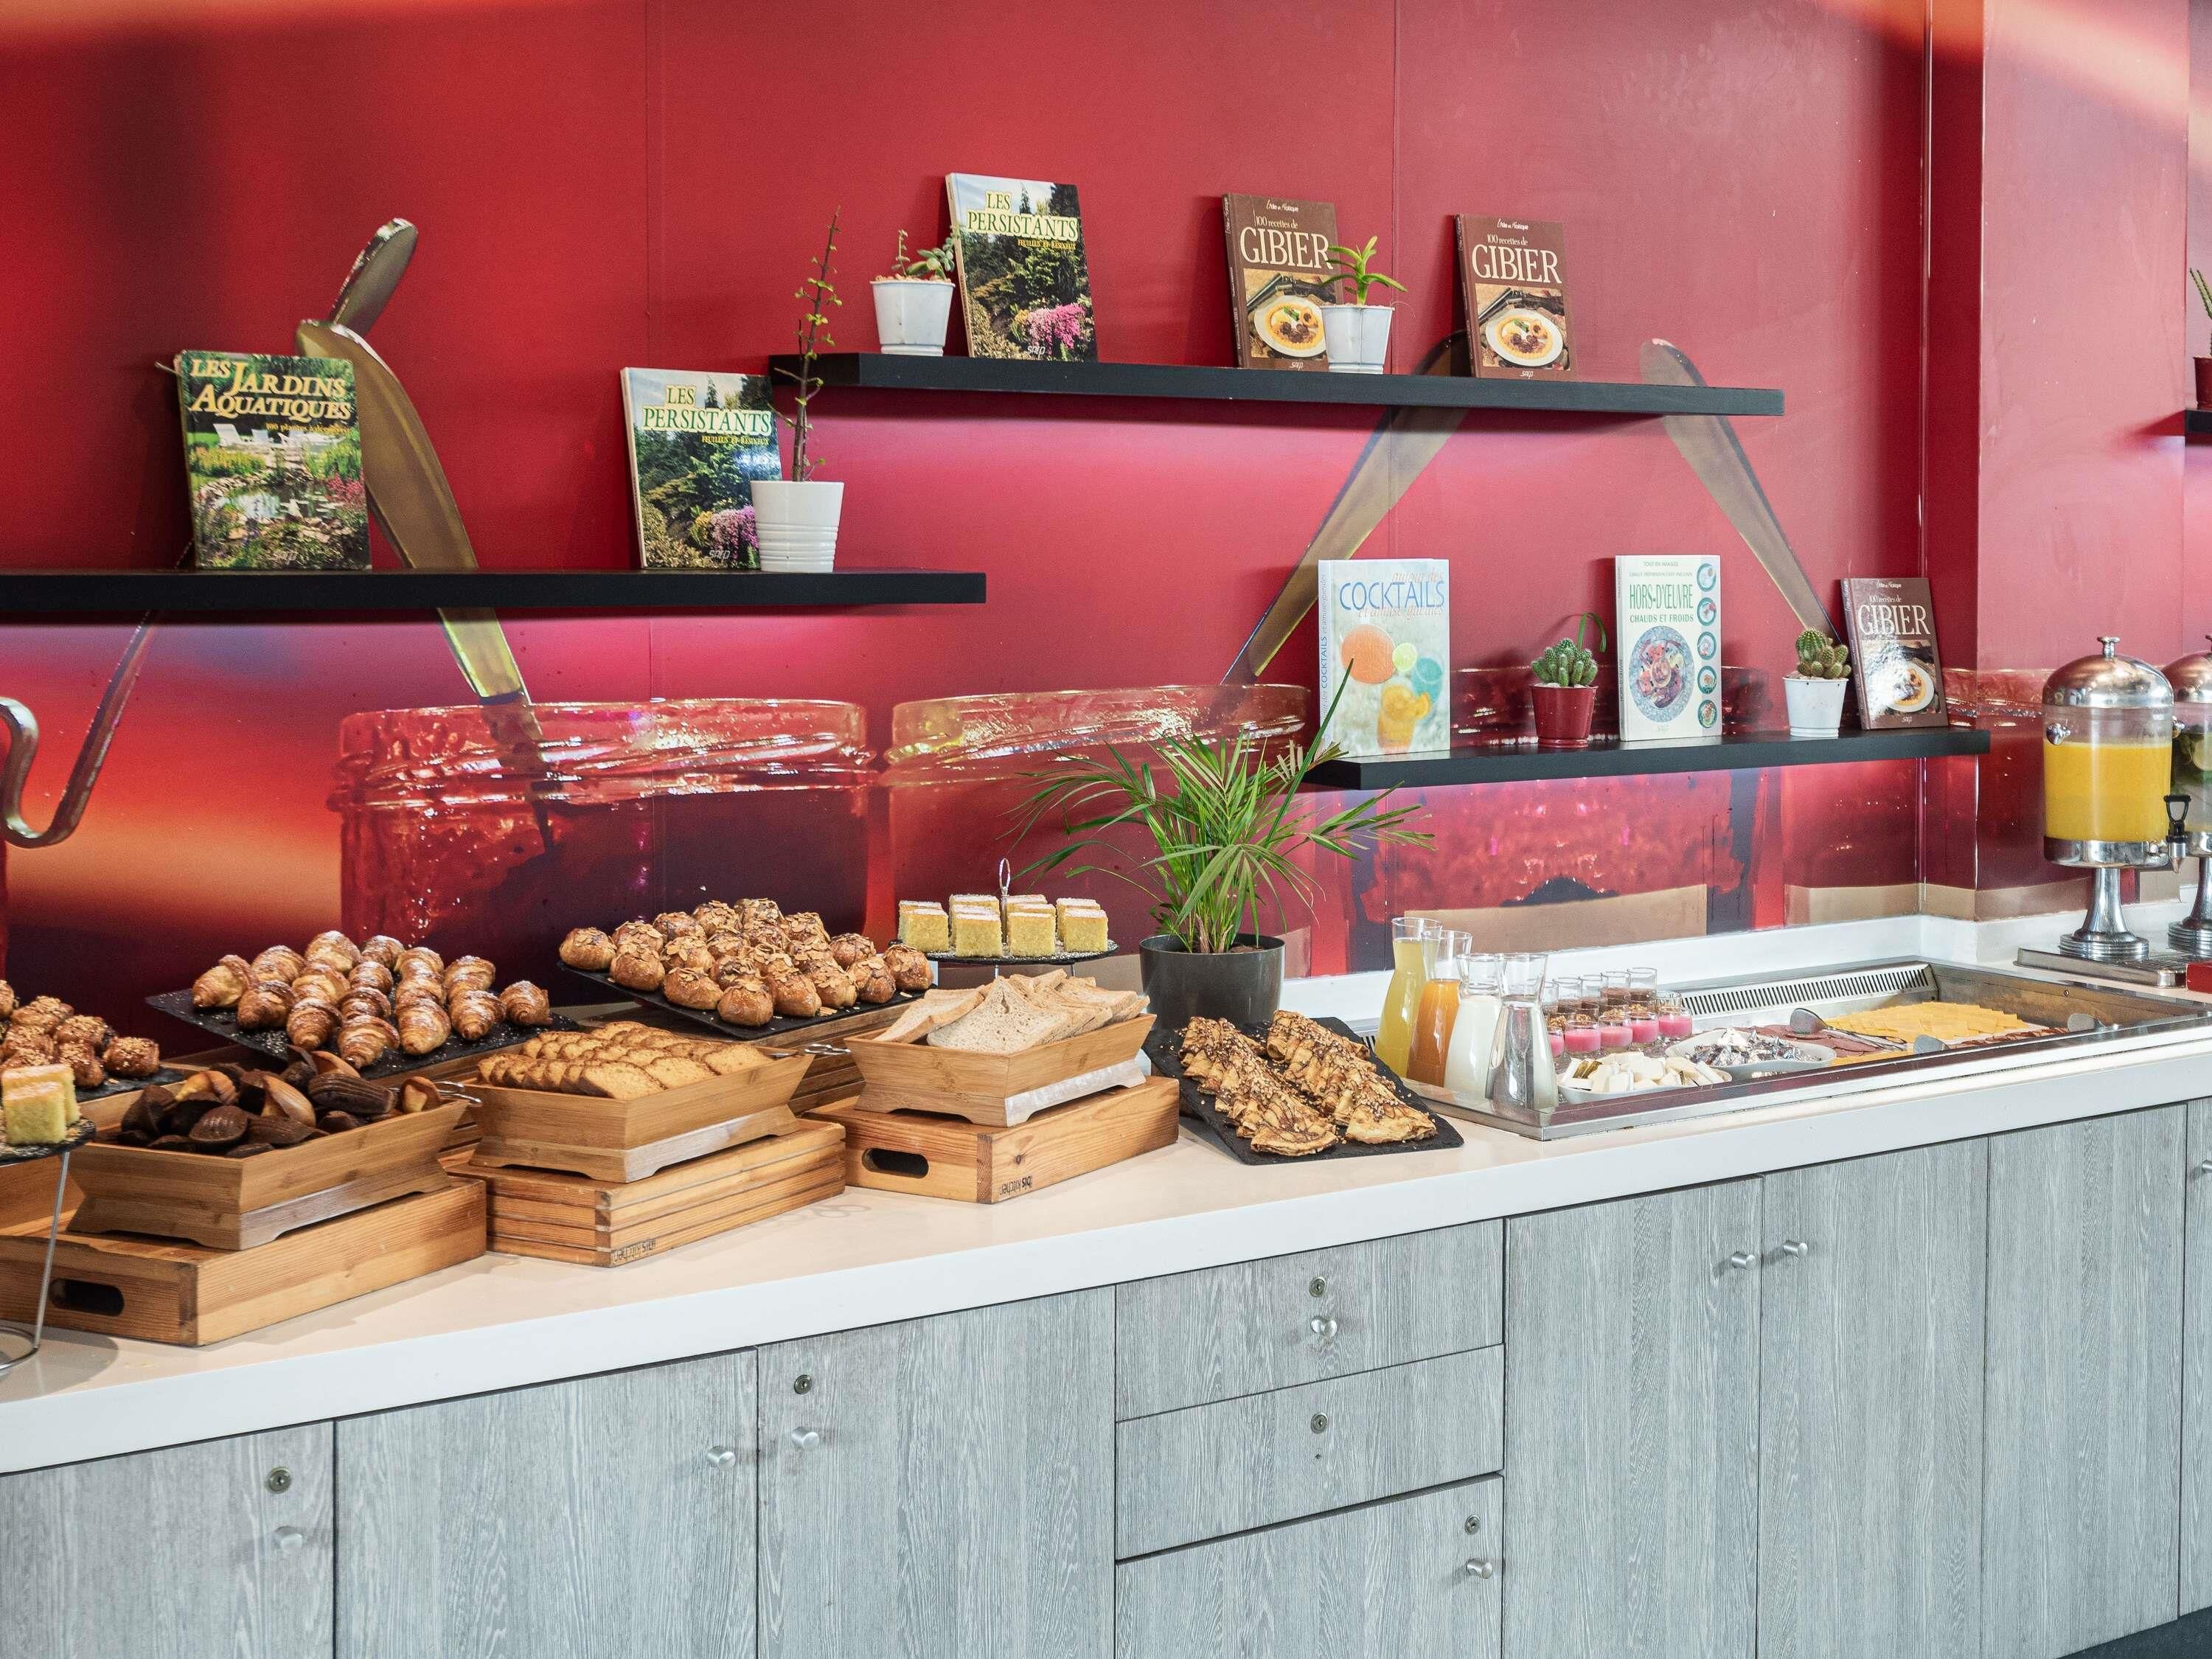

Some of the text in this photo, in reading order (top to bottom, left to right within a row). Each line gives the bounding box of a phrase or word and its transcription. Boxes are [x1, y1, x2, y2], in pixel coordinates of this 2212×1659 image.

[987, 193, 1011, 211] LES
[967, 211, 1078, 240] PERSISTANTS
[1256, 215, 1298, 229] 100 recettes de
[1239, 226, 1334, 270] GIBIER
[1487, 234, 1528, 246] 100 recettes de
[1472, 244, 1562, 284] GIBIER
[190, 358, 348, 398] LES JARDINS
[189, 383, 352, 423] AQUATIQUES
[667, 387, 695, 406] LES
[642, 406, 771, 434] PERSISTANTS
[1339, 580, 1444, 611] COCKTAILS
[1630, 613, 1694, 623] CHAUDS ET FROIDS
[1857, 605, 1930, 636] GIBIER
